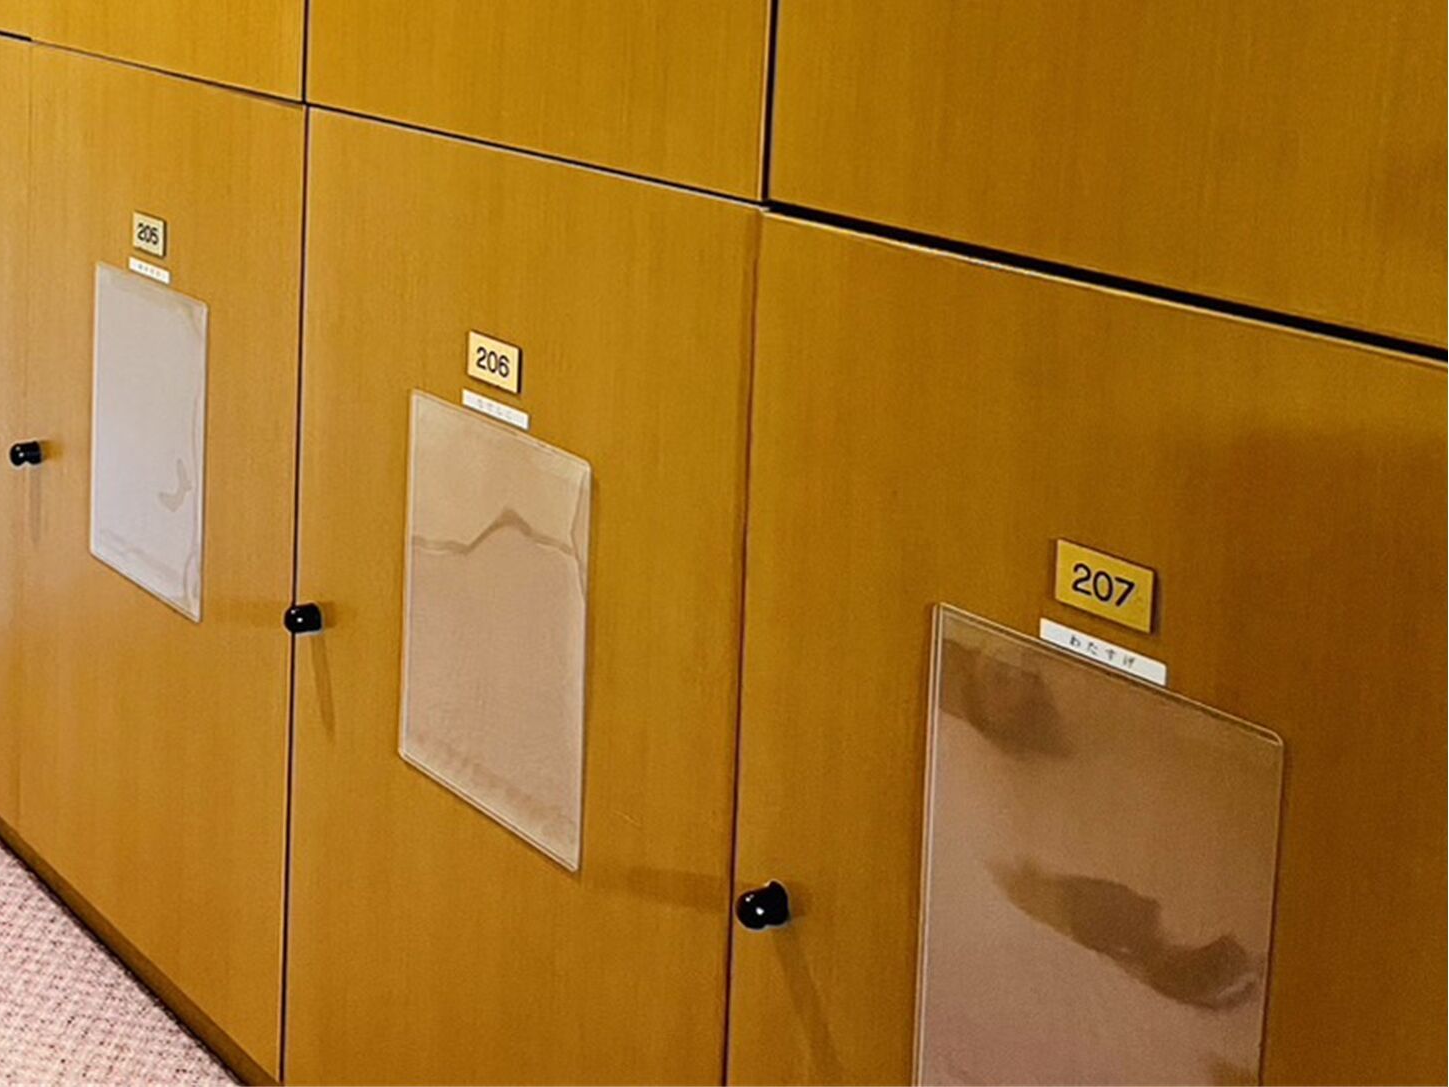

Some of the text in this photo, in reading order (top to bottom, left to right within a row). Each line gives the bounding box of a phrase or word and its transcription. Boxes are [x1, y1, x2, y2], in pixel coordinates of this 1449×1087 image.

[137, 222, 159, 245] 205
[476, 346, 510, 378] 206
[1072, 563, 1136, 607] 207
[1069, 634, 1136, 669] わたすげ
